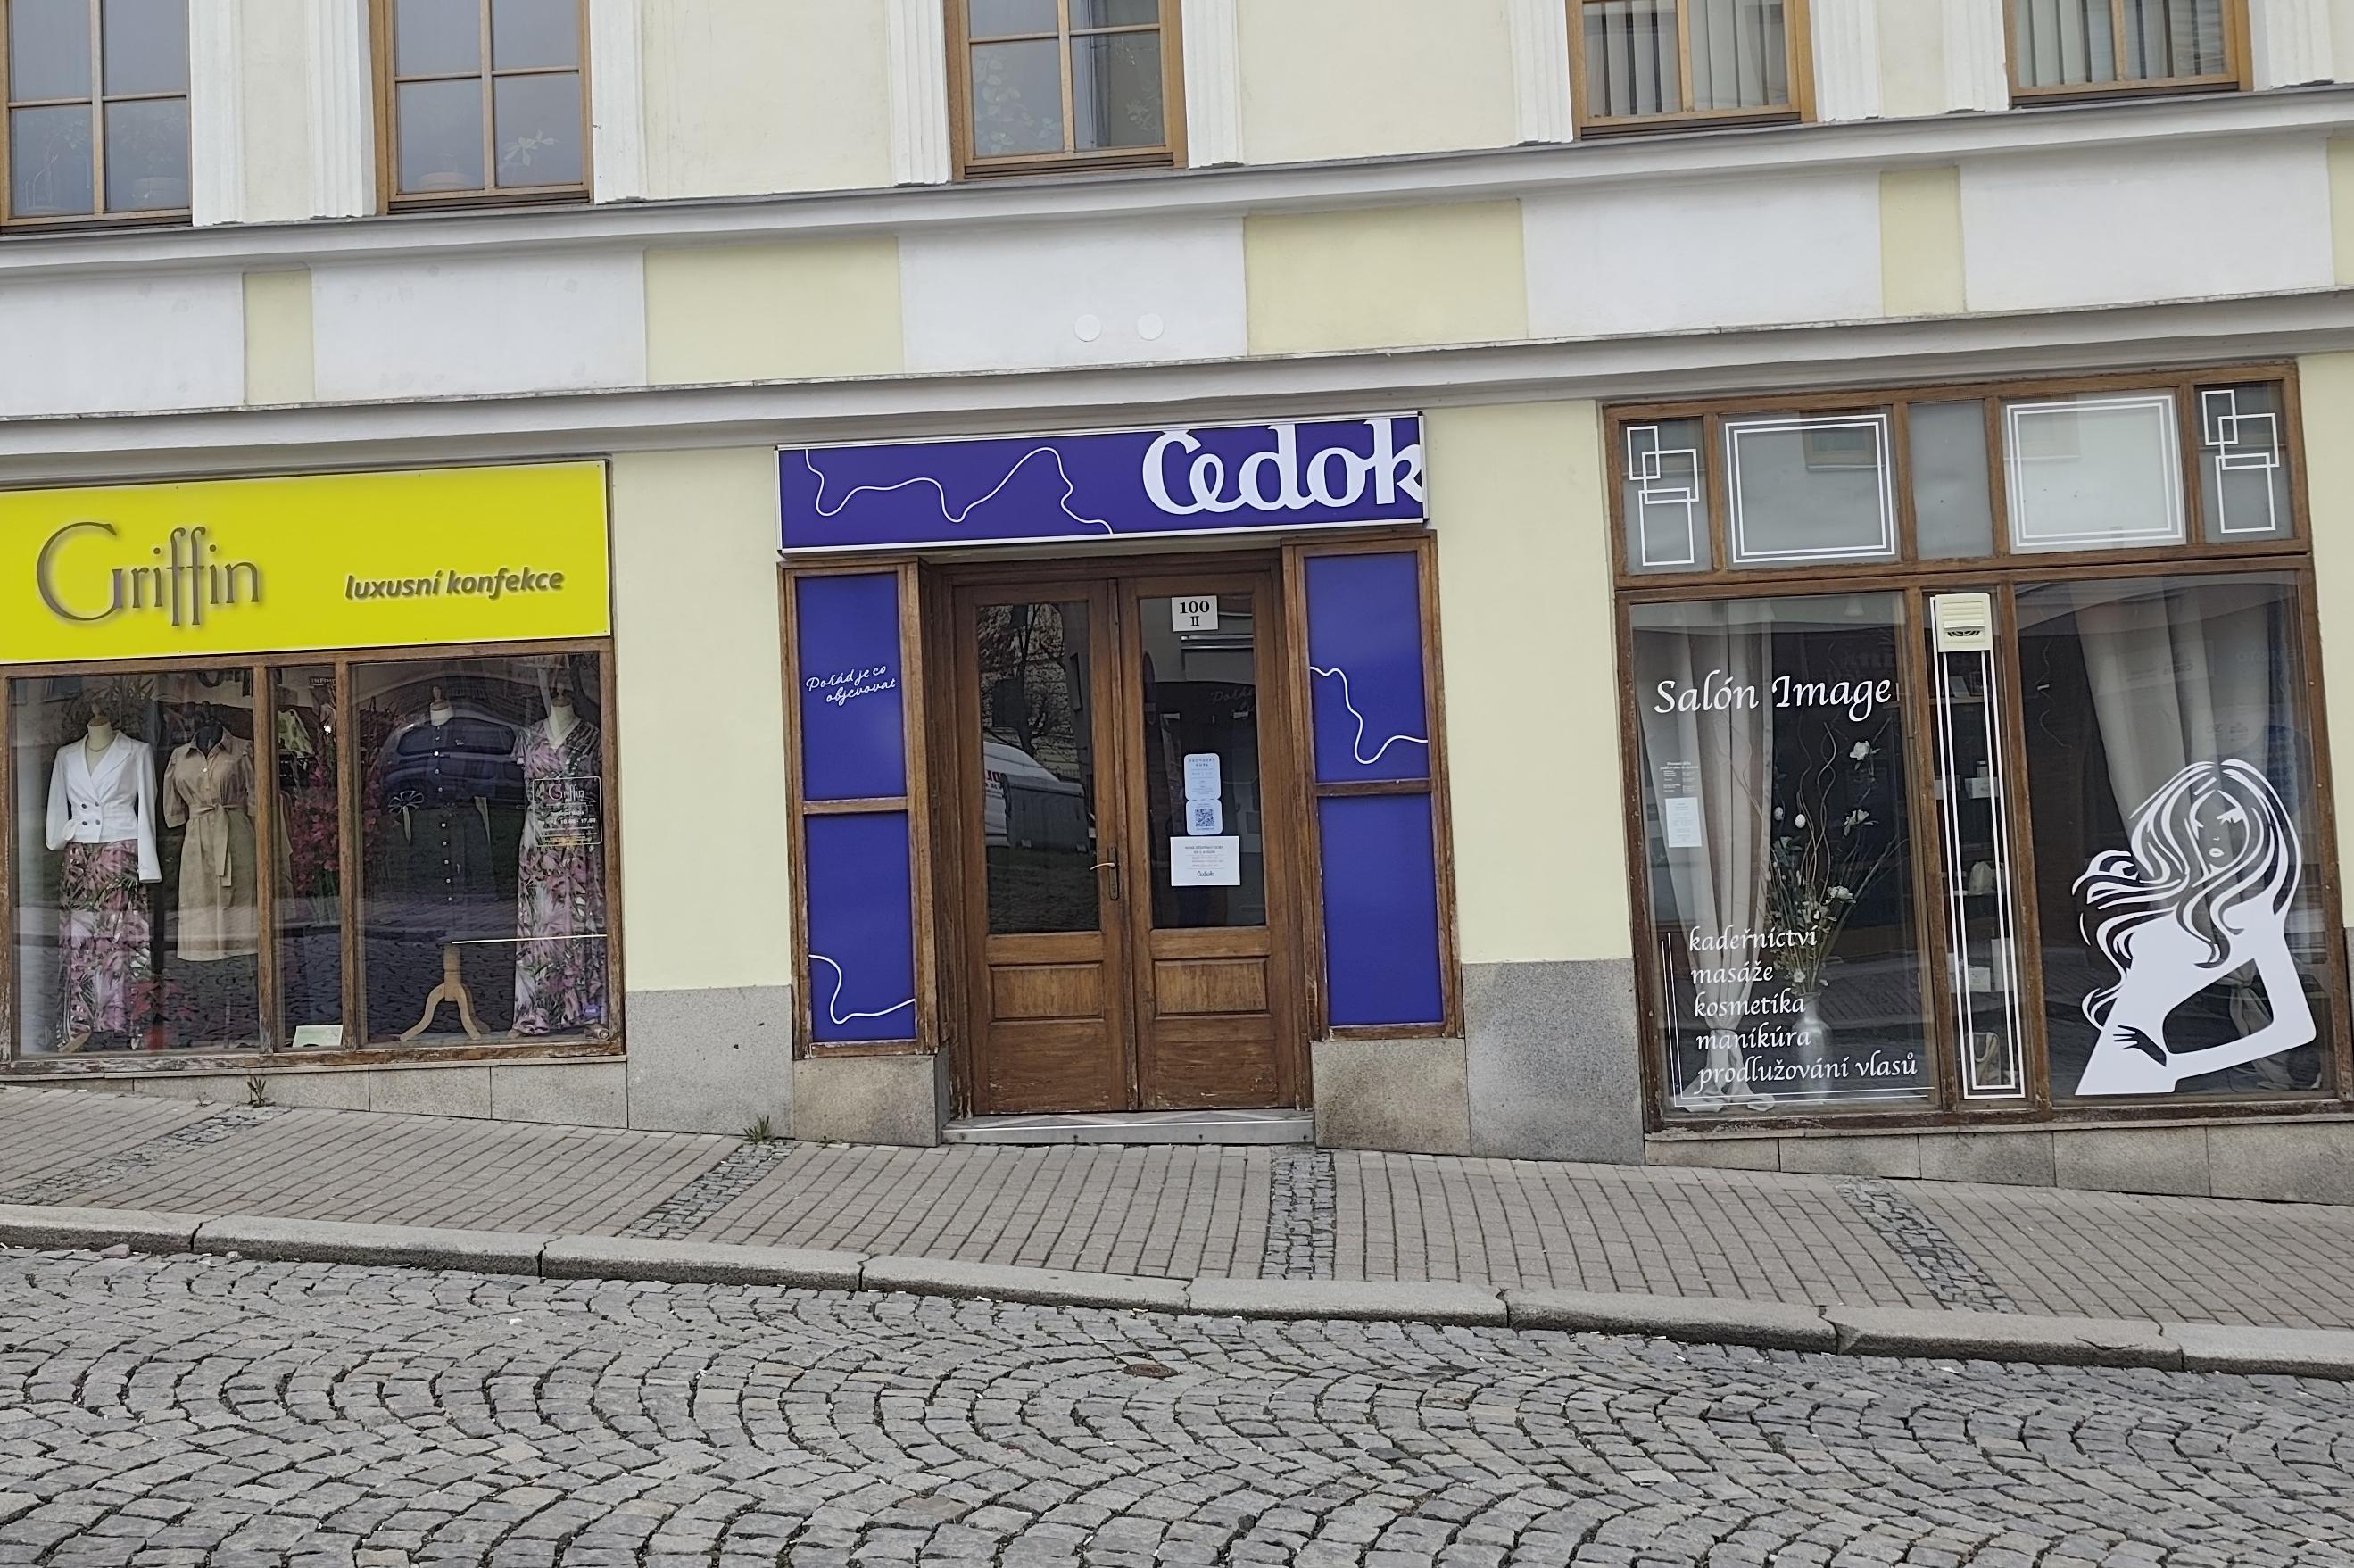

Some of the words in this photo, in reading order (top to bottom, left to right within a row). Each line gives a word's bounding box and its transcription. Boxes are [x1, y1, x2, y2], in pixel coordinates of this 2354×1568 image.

[36, 521, 260, 626] Griffin
[344, 569, 443, 601] luxusní
[446, 566, 564, 601] konfekce
[1180, 600, 1210, 614] 100
[1189, 615, 1200, 627] II
[806, 668, 855, 692] Pořád
[854, 669, 870, 686] je
[873, 666, 886, 676] co
[826, 678, 896, 706] objevovat
[1654, 669, 1760, 713] Salón
[1771, 675, 1892, 722] Image
[1689, 924, 1819, 951] kadeřnictví
[1690, 959, 1774, 984] masáže
[1695, 987, 1807, 1017] kosmetika
[1695, 1021, 1811, 1050] manikúra
[1693, 1055, 1850, 1095] prodlužování
[1854, 1049, 1918, 1077] vlasů
